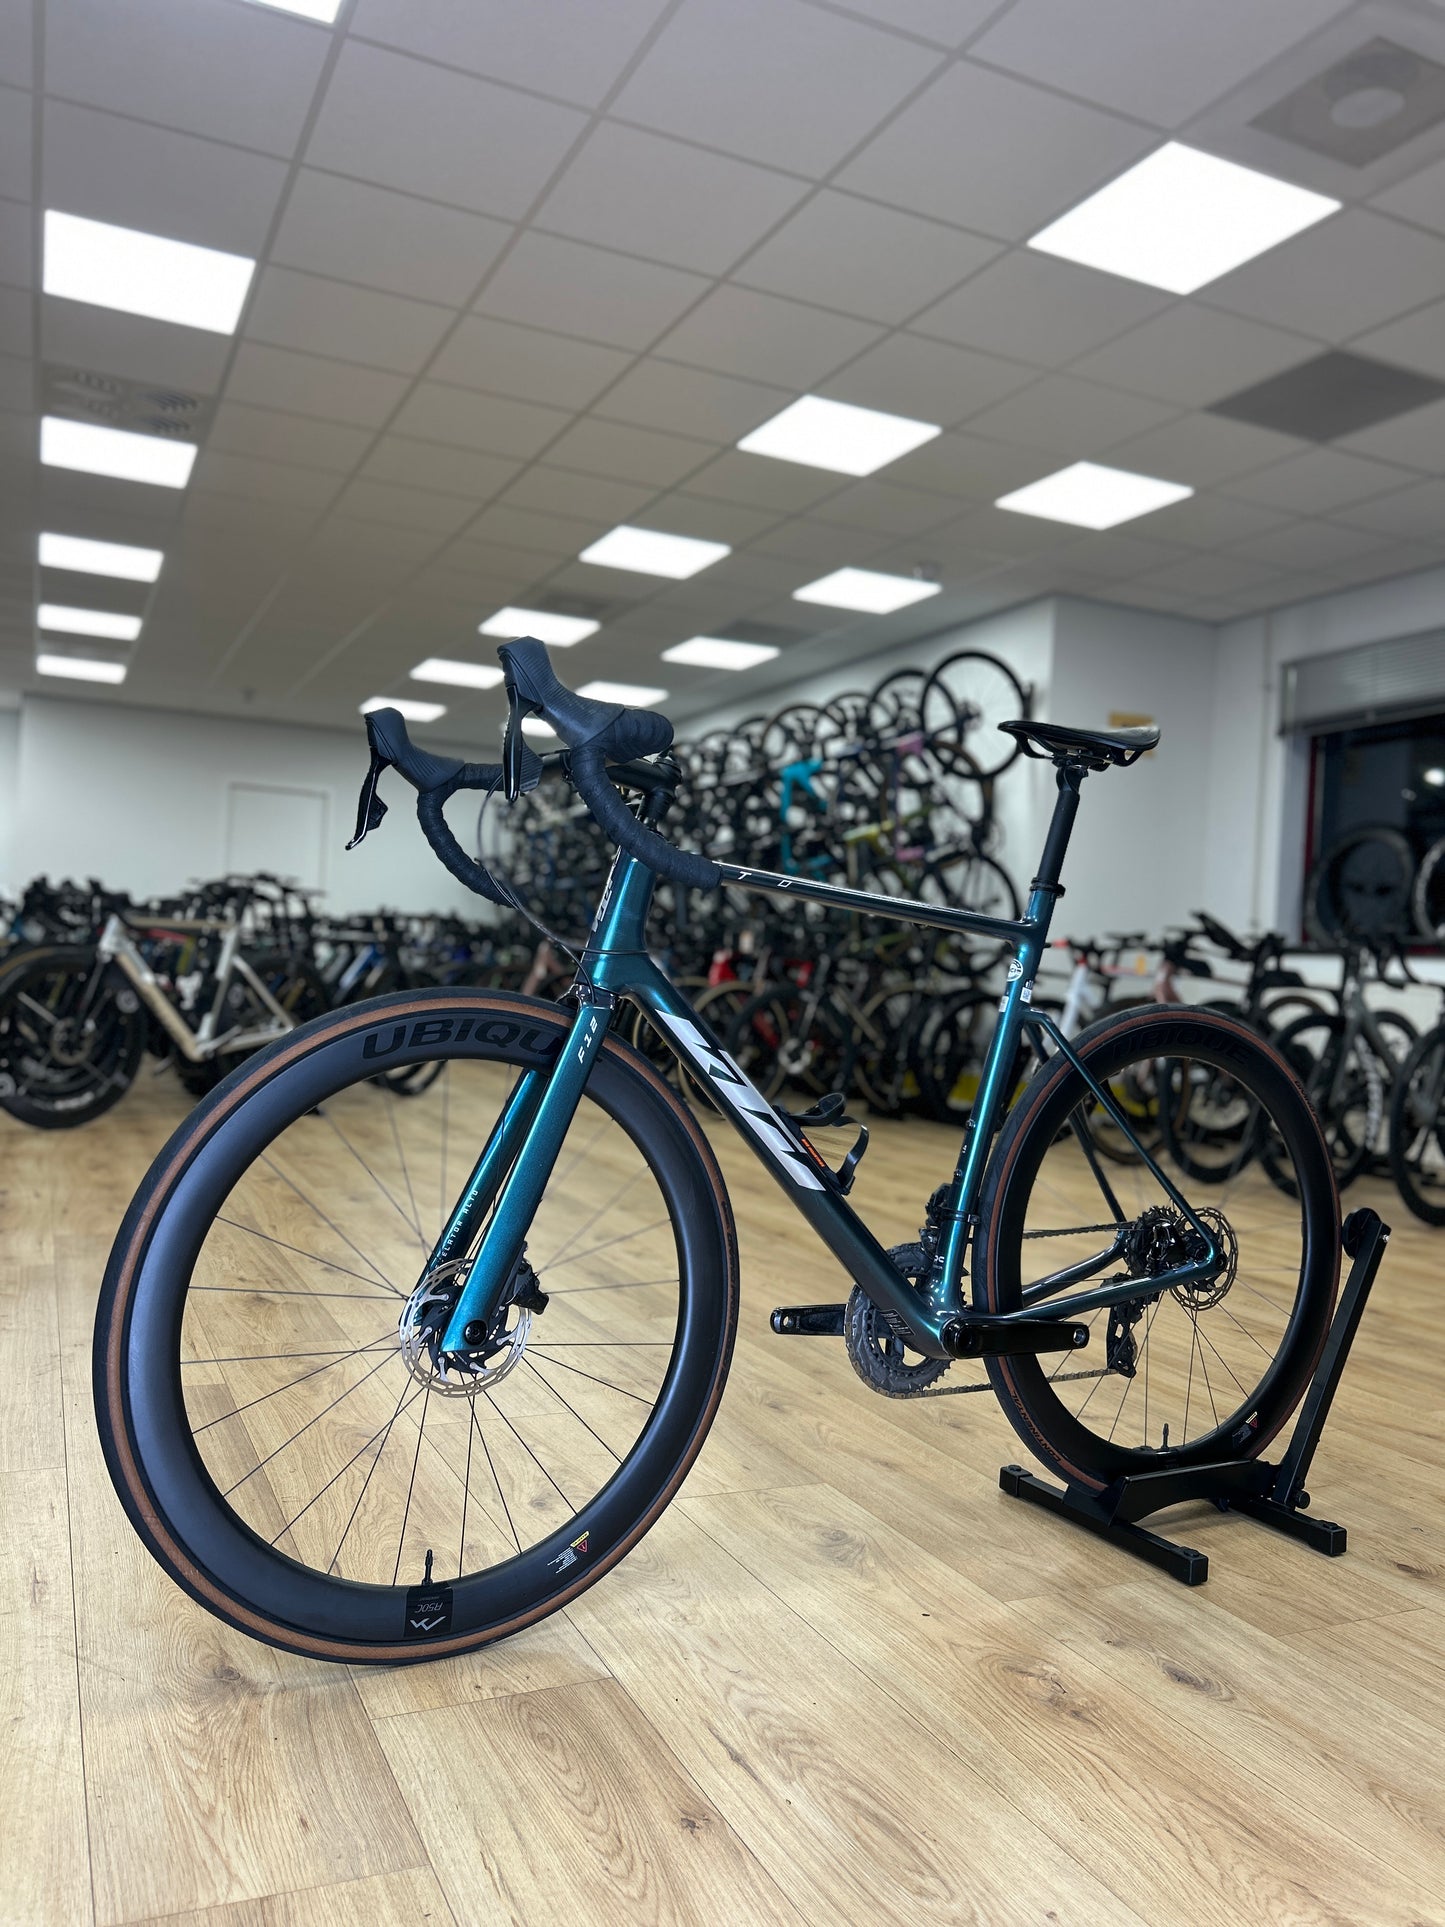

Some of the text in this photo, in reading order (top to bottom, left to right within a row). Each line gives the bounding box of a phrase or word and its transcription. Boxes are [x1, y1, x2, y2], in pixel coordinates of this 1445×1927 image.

[737, 871, 793, 888] TO
[362, 1018, 564, 1060] UBIQU
[437, 1220, 463, 1263] ELATOR
